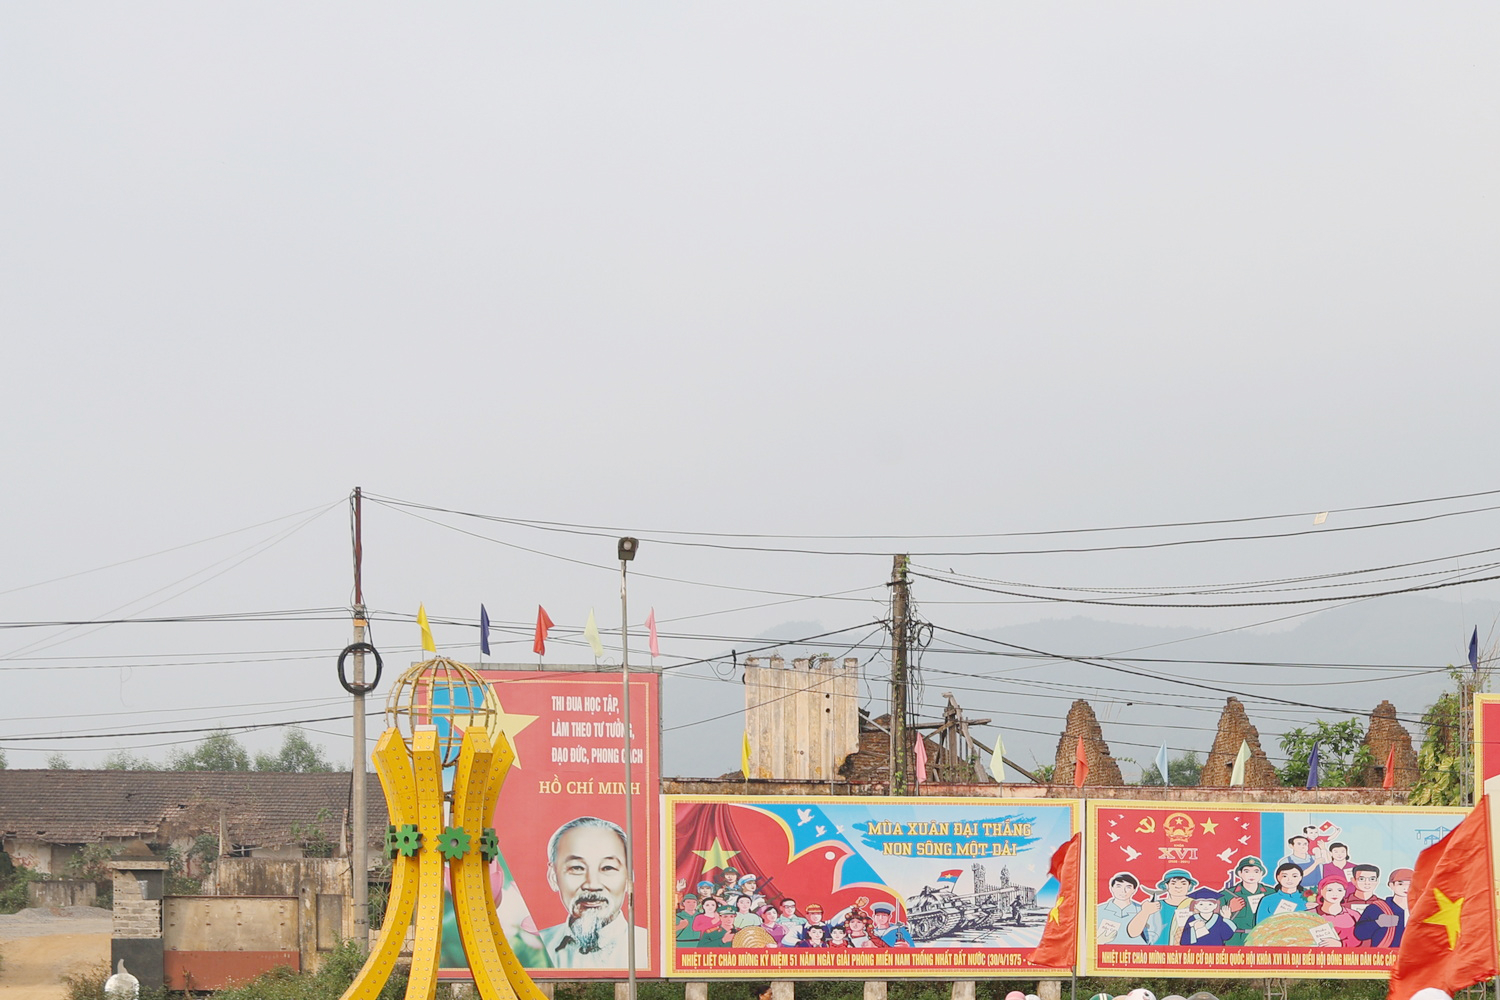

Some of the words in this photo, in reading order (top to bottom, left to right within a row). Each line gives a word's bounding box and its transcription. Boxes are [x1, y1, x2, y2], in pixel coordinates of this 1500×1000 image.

[551, 696, 564, 711] THI
[566, 696, 582, 711] ĐUA
[584, 697, 601, 715] HỌC
[603, 694, 619, 715] TẬP,
[551, 718, 569, 737] LÀM
[571, 722, 592, 737] THEO
[593, 721, 605, 737] TƯ
[551, 747, 568, 765] ĐẠO
[570, 745, 589, 764] ĐỨC,
[591, 748, 619, 763] PHONG
[539, 774, 562, 794] HỒ
[566, 777, 593, 794] CHÍ
[598, 782, 640, 794] MINH
[867, 819, 903, 836] MÙA
[907, 820, 950, 836] XUÂN
[953, 822, 978, 838] ĐẠI
[982, 818, 1032, 837] THẮNG
[882, 842, 913, 856] NON
[916, 841, 953, 856] SÔNG
[956, 841, 988, 858] MỘT
[1158, 847, 1198, 860] XVI
[682, 953, 701, 969] NHIỆT
[703, 953, 716, 969] LIỆT
[718, 952, 736, 967] CHÀO
[738, 951, 758, 967] MỪNG
[770, 953, 788, 969] NIỆM
[789, 954, 798, 967] 51
[800, 951, 816, 967] NĂM
[817, 951, 835, 967] NGÀY
[836, 950, 850, 967] GIẢI
[851, 952, 874, 966] PHÓNG
[875, 950, 893, 966] MIỀN
[894, 953, 910, 966] NAM
[912, 950, 933, 966] THỐNG
[935, 950, 952, 966] NHẤT
[953, 950, 967, 966] ĐẤT
[968, 951, 985, 966] NƯỚC
[987, 953, 1022, 967] (30/4/1975
[1102, 949, 1118, 966] NHIỆT
[1119, 949, 1131, 966] LIỆT
[1132, 950, 1148, 964] CHÀO
[1149, 950, 1166, 964] MỪNG
[1167, 950, 1181, 964] NGÀY
[1205, 952, 1214, 967] ĐẠI
[1215, 949, 1228, 965] BIỂU
[1229, 949, 1244, 966] QUỐC
[1246, 951, 1255, 967] HỘI
[1273, 953, 1282, 965] XVI
[1283, 951, 1290, 965] VÀ
[1291, 953, 1300, 967] ĐẠI
[1302, 949, 1315, 965] BIỂU
[1316, 952, 1325, 967] HỘI
[1327, 950, 1342, 965] ĐỒNG
[1343, 952, 1359, 965] NHÂN
[1360, 952, 1371, 965] DÂN
[1372, 951, 1384, 966] CÁC
[1385, 950, 1397, 966] CẤP
